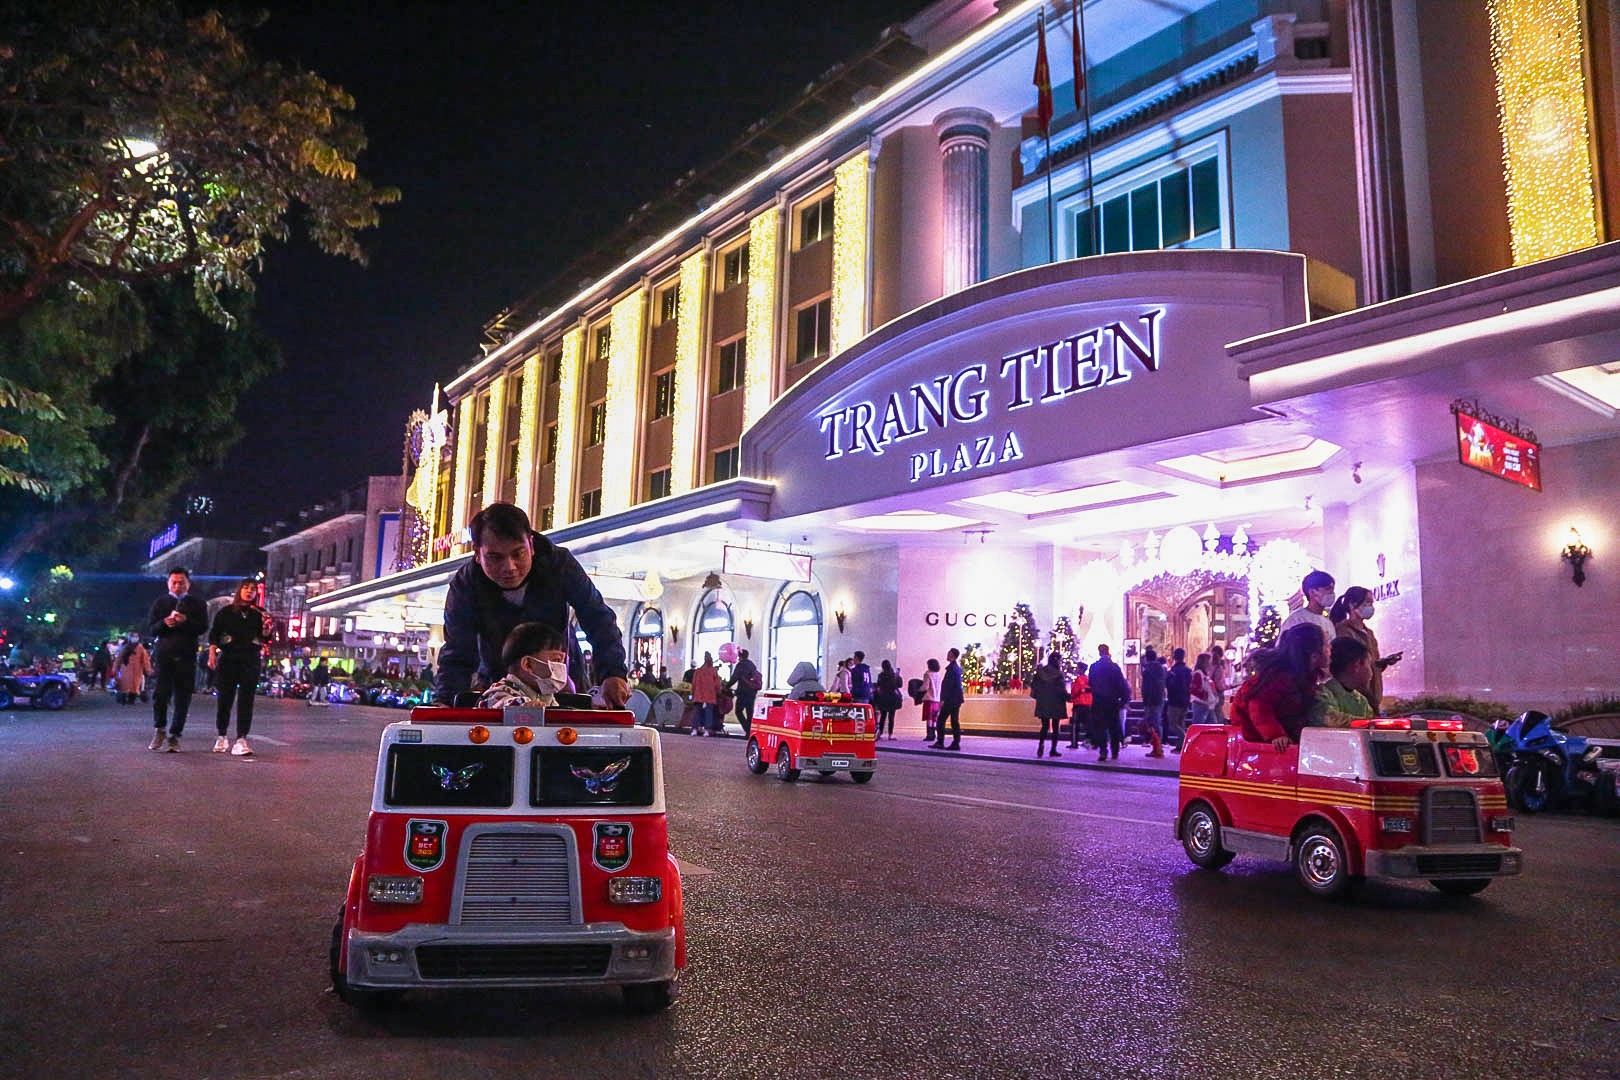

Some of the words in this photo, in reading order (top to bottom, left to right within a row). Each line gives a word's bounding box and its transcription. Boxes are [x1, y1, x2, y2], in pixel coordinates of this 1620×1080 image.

[820, 362, 988, 460] TRANG
[1000, 306, 1167, 411] TIEN
[909, 431, 1024, 483] PLAZA
[1372, 579, 1401, 601] OLEX
[925, 611, 1007, 628] GUCCI
